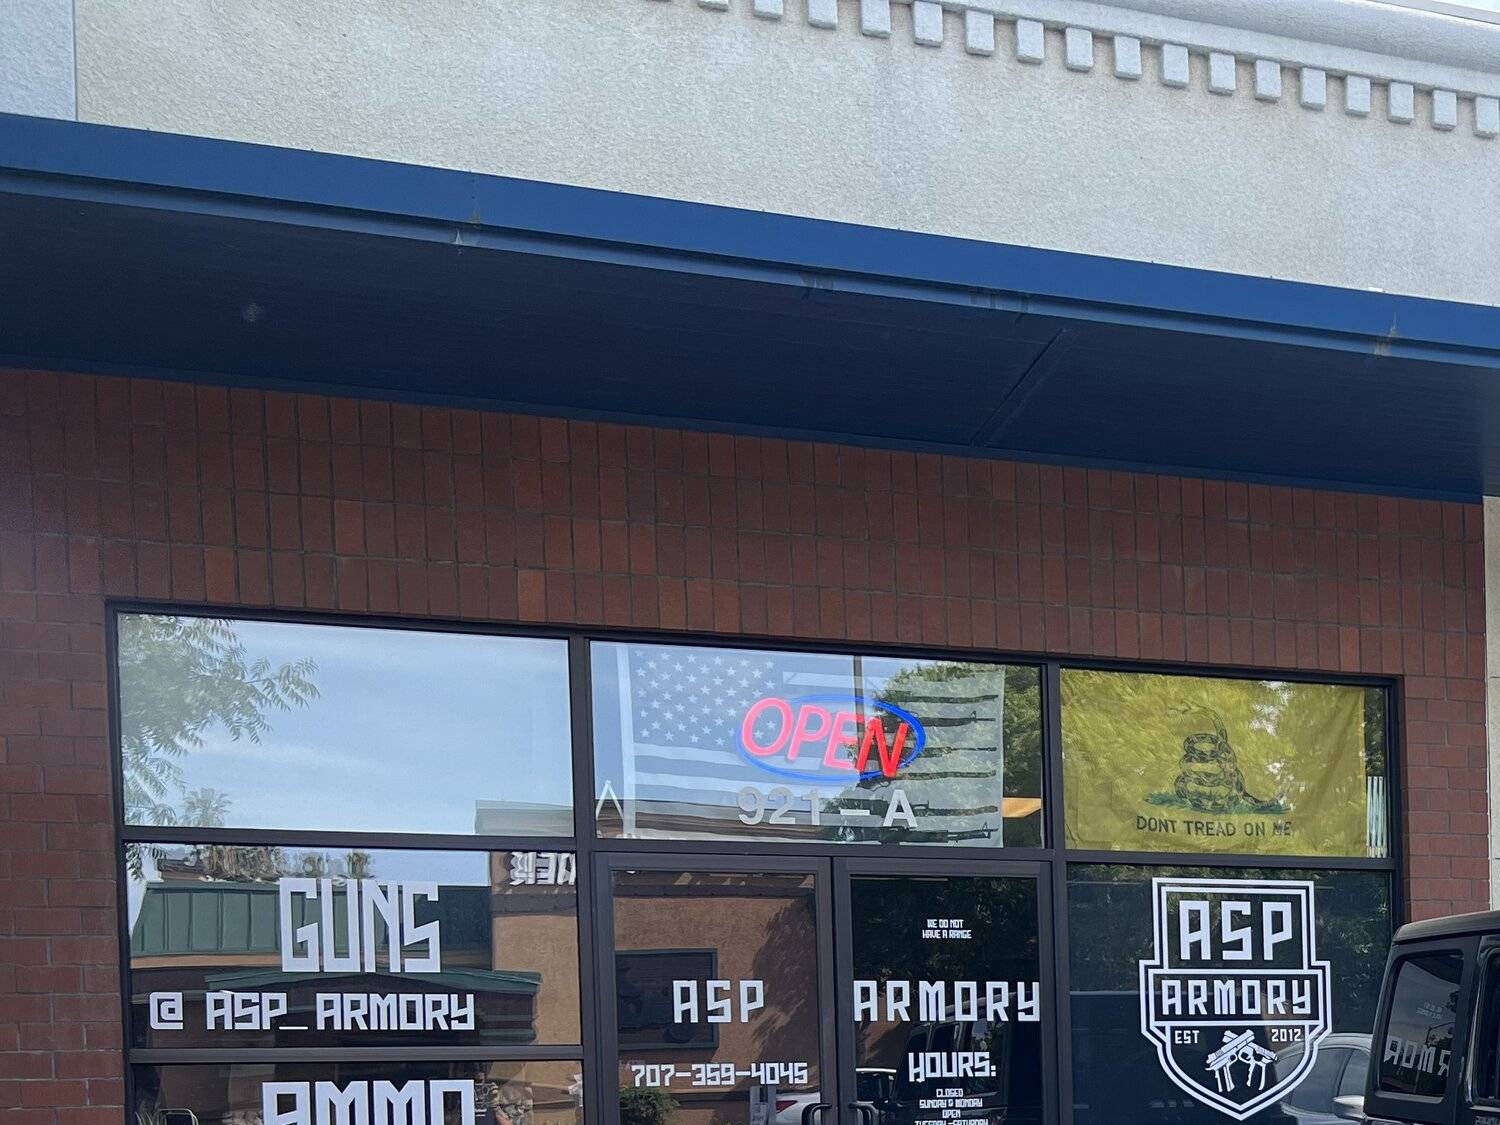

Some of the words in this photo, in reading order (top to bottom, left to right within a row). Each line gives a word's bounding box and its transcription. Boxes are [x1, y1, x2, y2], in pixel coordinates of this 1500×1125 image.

[742, 698, 910, 778] OPEN
[736, 786, 918, 829] 921-A
[1136, 815, 1177, 833] DONT
[1183, 819, 1236, 837] TREAD
[1244, 820, 1265, 837] ON
[1273, 819, 1292, 837] ME
[280, 878, 441, 974] GUNS
[922, 929, 941, 939] HAVE
[942, 929, 948, 939] A
[949, 929, 972, 939] RANGE
[927, 918, 938, 929] WE
[939, 918, 949, 929] DO
[950, 918, 964, 929] NOT
[1179, 900, 1293, 961] ASP
[673, 979, 764, 1024] ASP
[853, 979, 1041, 1022] ARMORY
[1161, 979, 1311, 1015] ARMORY
[1174, 1029, 1200, 1044] EST
[1271, 1028, 1301, 1043] 2012
[631, 1062, 808, 1086] 707-359-4045
[908, 1051, 997, 1083] HOURS:
[919, 1099, 947, 1109] SUNDAY
[955, 1098, 983, 1108] MONDAY
[936, 1088, 963, 1098] CLOSED
[942, 1109, 961, 1118] OPEN
